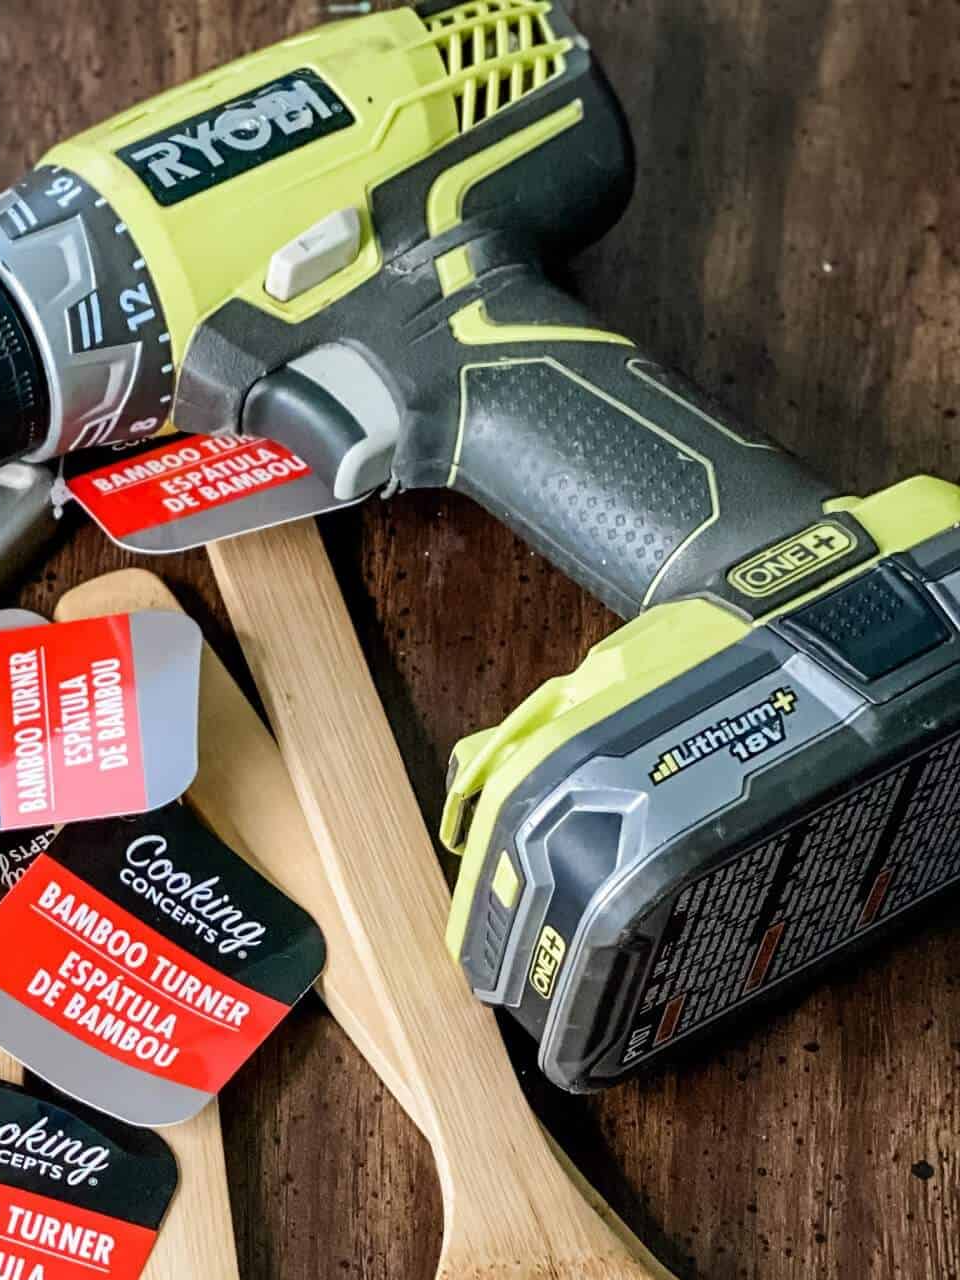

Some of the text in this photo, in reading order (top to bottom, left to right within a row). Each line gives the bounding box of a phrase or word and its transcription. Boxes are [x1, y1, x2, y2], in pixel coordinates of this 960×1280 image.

[131, 79, 333, 188] RYOBI
[120, 282, 156, 331] 12
[92, 447, 201, 493] BAMBOO
[159, 447, 279, 495] ESPÁTULA
[162, 455, 308, 513] DE BAMBOU
[9, 648, 48, 815] BAMBOO TURNER
[54, 674, 94, 768] ESPÁTULA
[91, 657, 129, 773] DE BAMBOU
[731, 720, 785, 761] 18V
[119, 868, 219, 945] CONCEPTS
[125, 834, 266, 953] Cooking
[37, 880, 250, 1027] BAMBOO TURNER
[58, 951, 178, 1040] ESPÁTULA
[26, 968, 180, 1068] DE BAMBOU
[6, 1205, 115, 1265] TURNER
